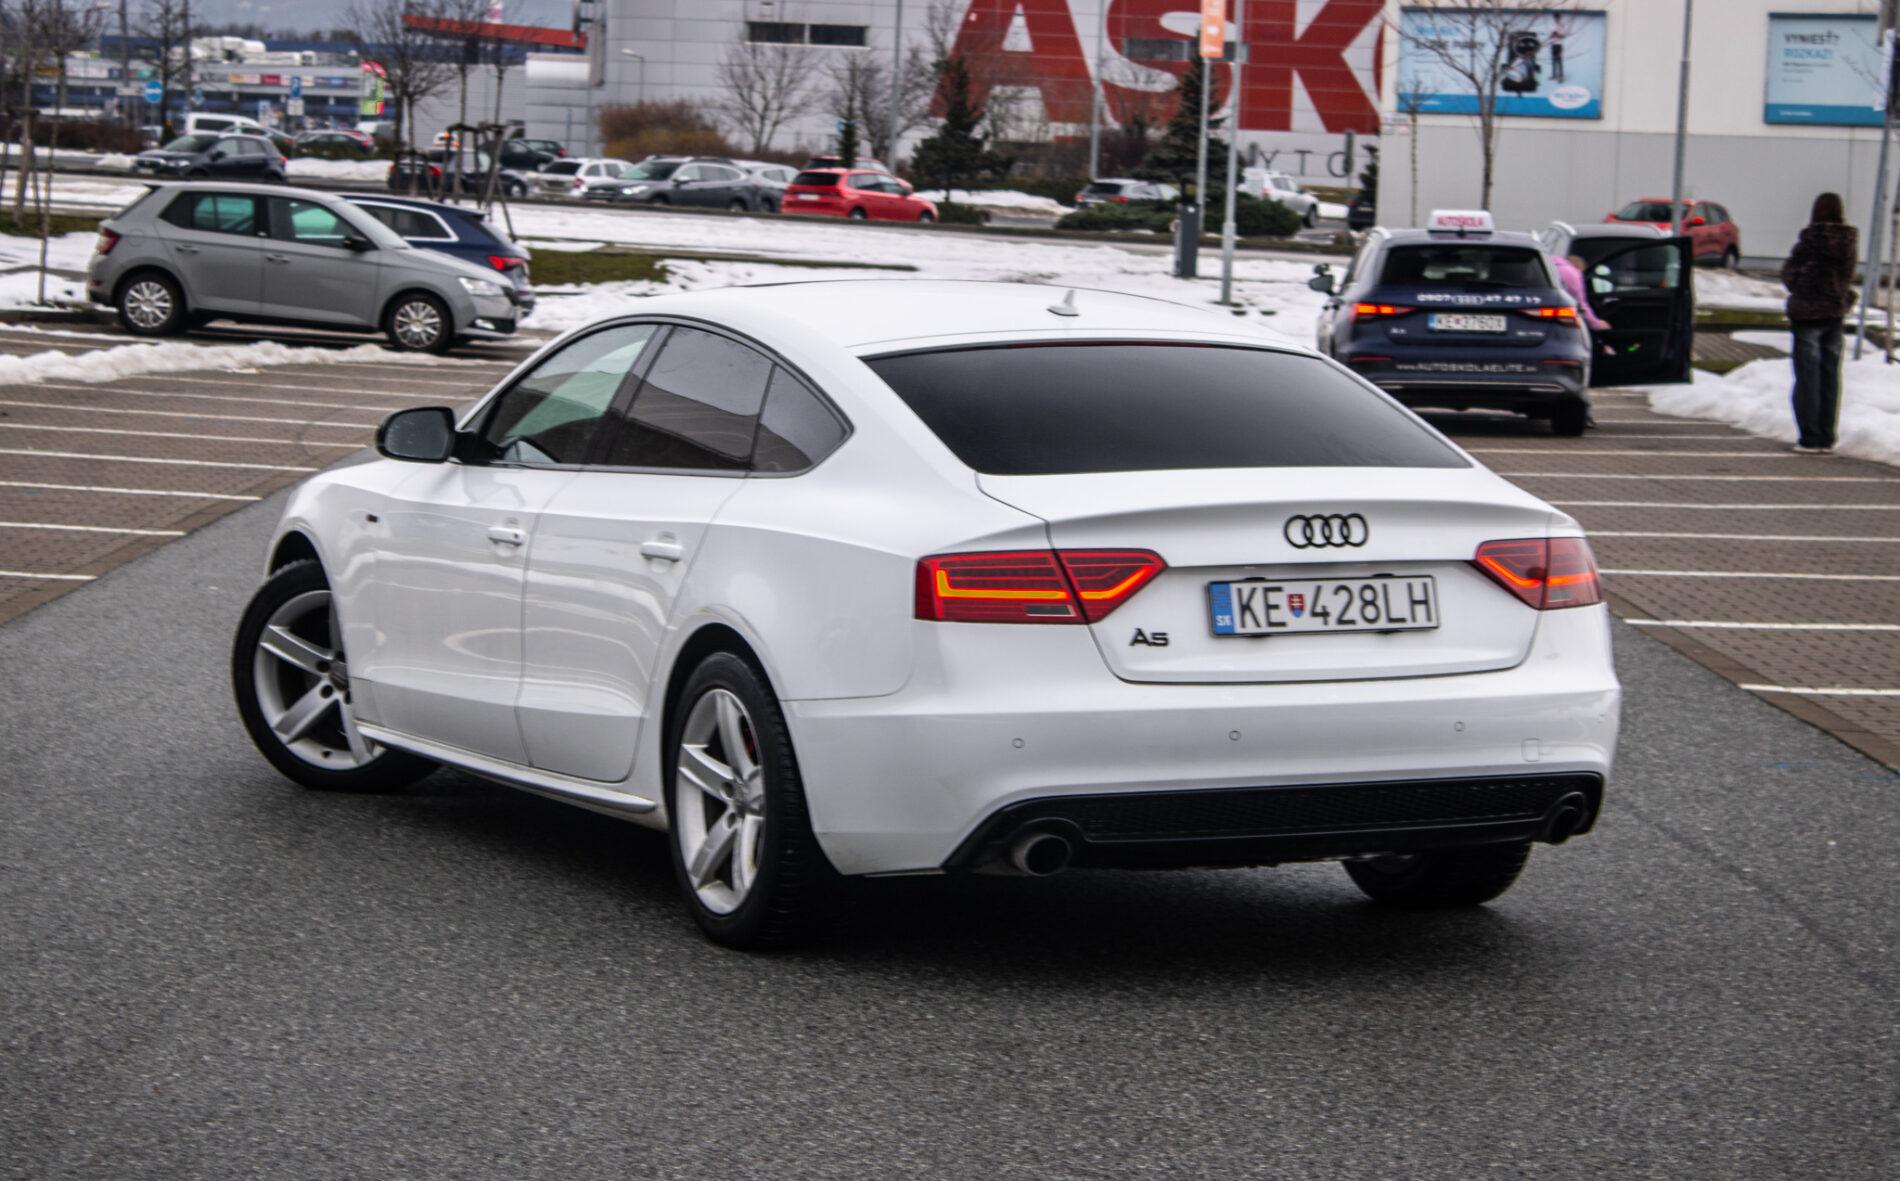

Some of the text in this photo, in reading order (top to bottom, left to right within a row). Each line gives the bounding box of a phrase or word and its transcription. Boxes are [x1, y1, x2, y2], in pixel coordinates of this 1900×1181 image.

[928, 0, 1383, 135] ASK
[1259, 150, 1353, 178] YTO
[1237, 581, 1433, 629] KE 428LH
[1129, 628, 1169, 647] A5
